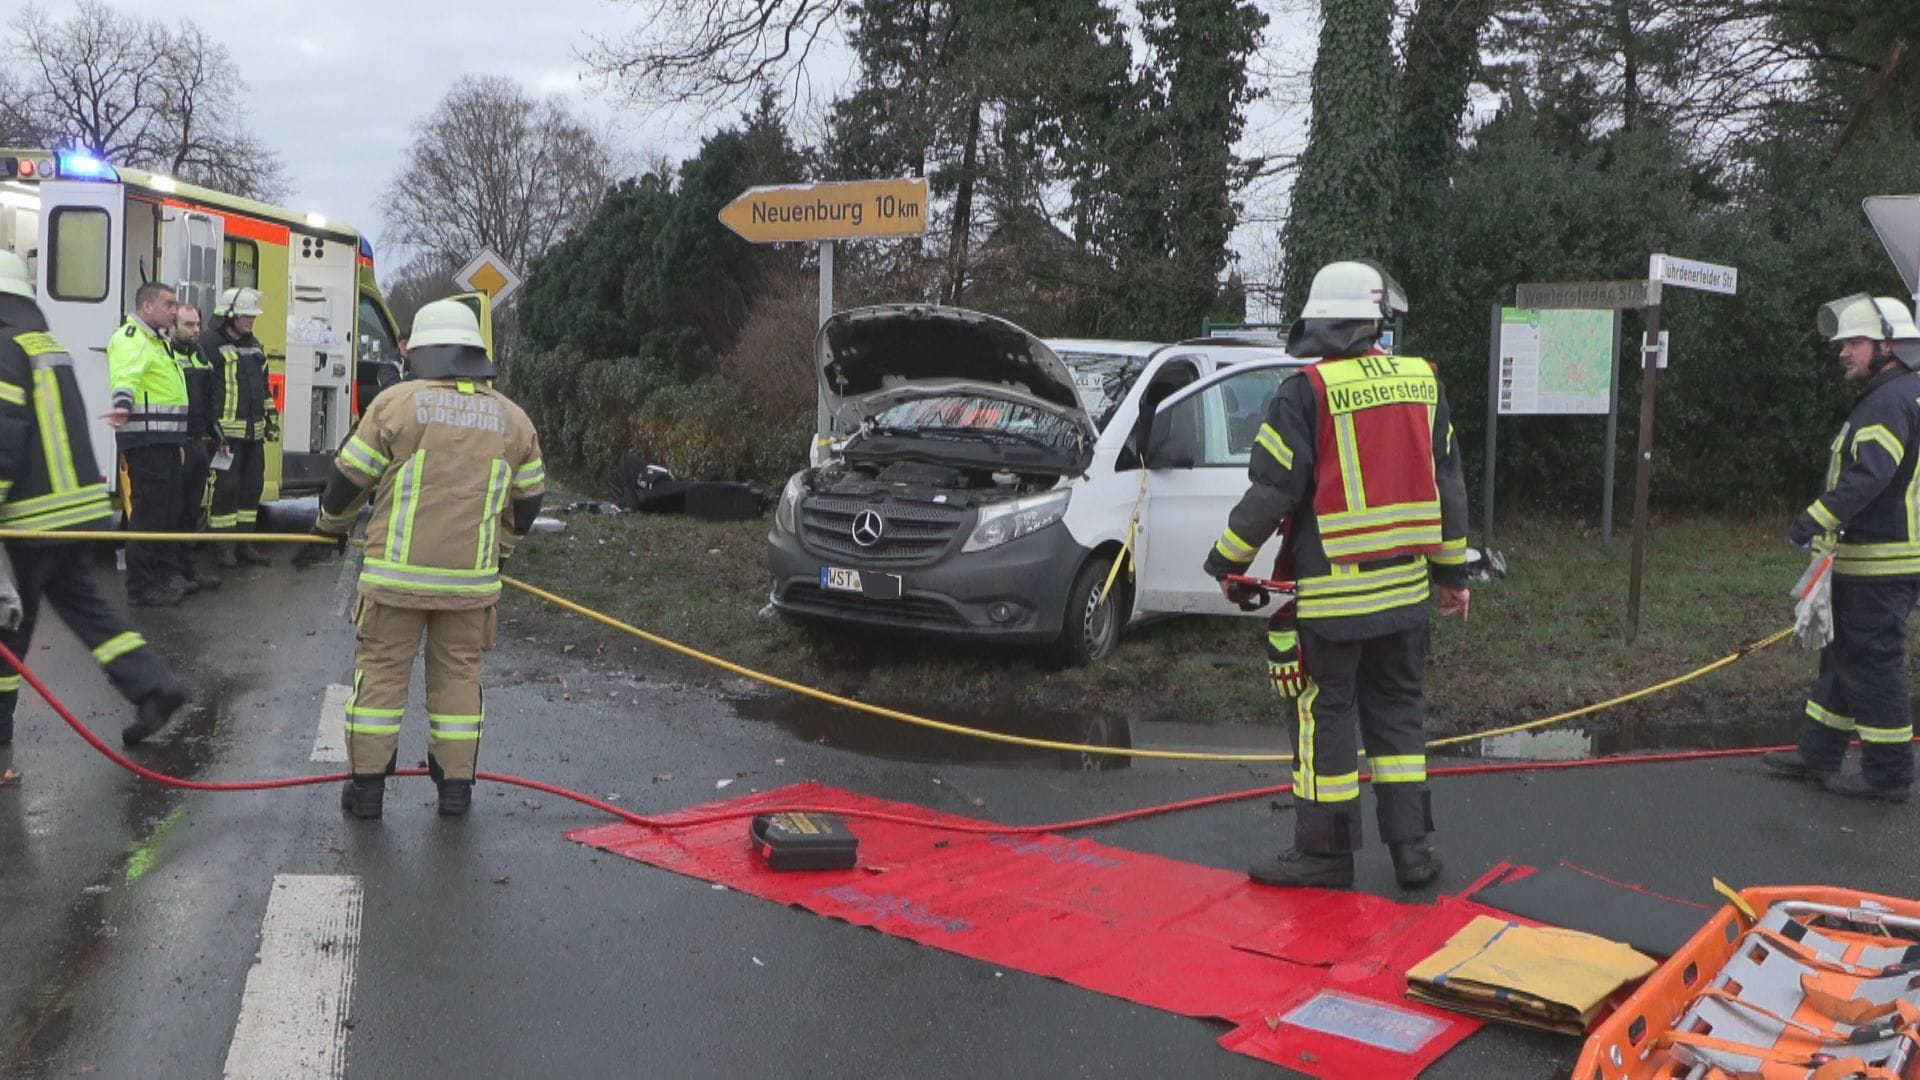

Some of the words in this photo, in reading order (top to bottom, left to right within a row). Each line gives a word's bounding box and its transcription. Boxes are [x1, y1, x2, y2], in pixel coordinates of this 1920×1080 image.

[752, 198, 863, 226] Neuenburg
[875, 195, 895, 219] 10
[898, 199, 919, 218] km
[1357, 357, 1400, 377] HLF
[1330, 381, 1435, 410] Westerstede
[829, 569, 853, 587] WST
